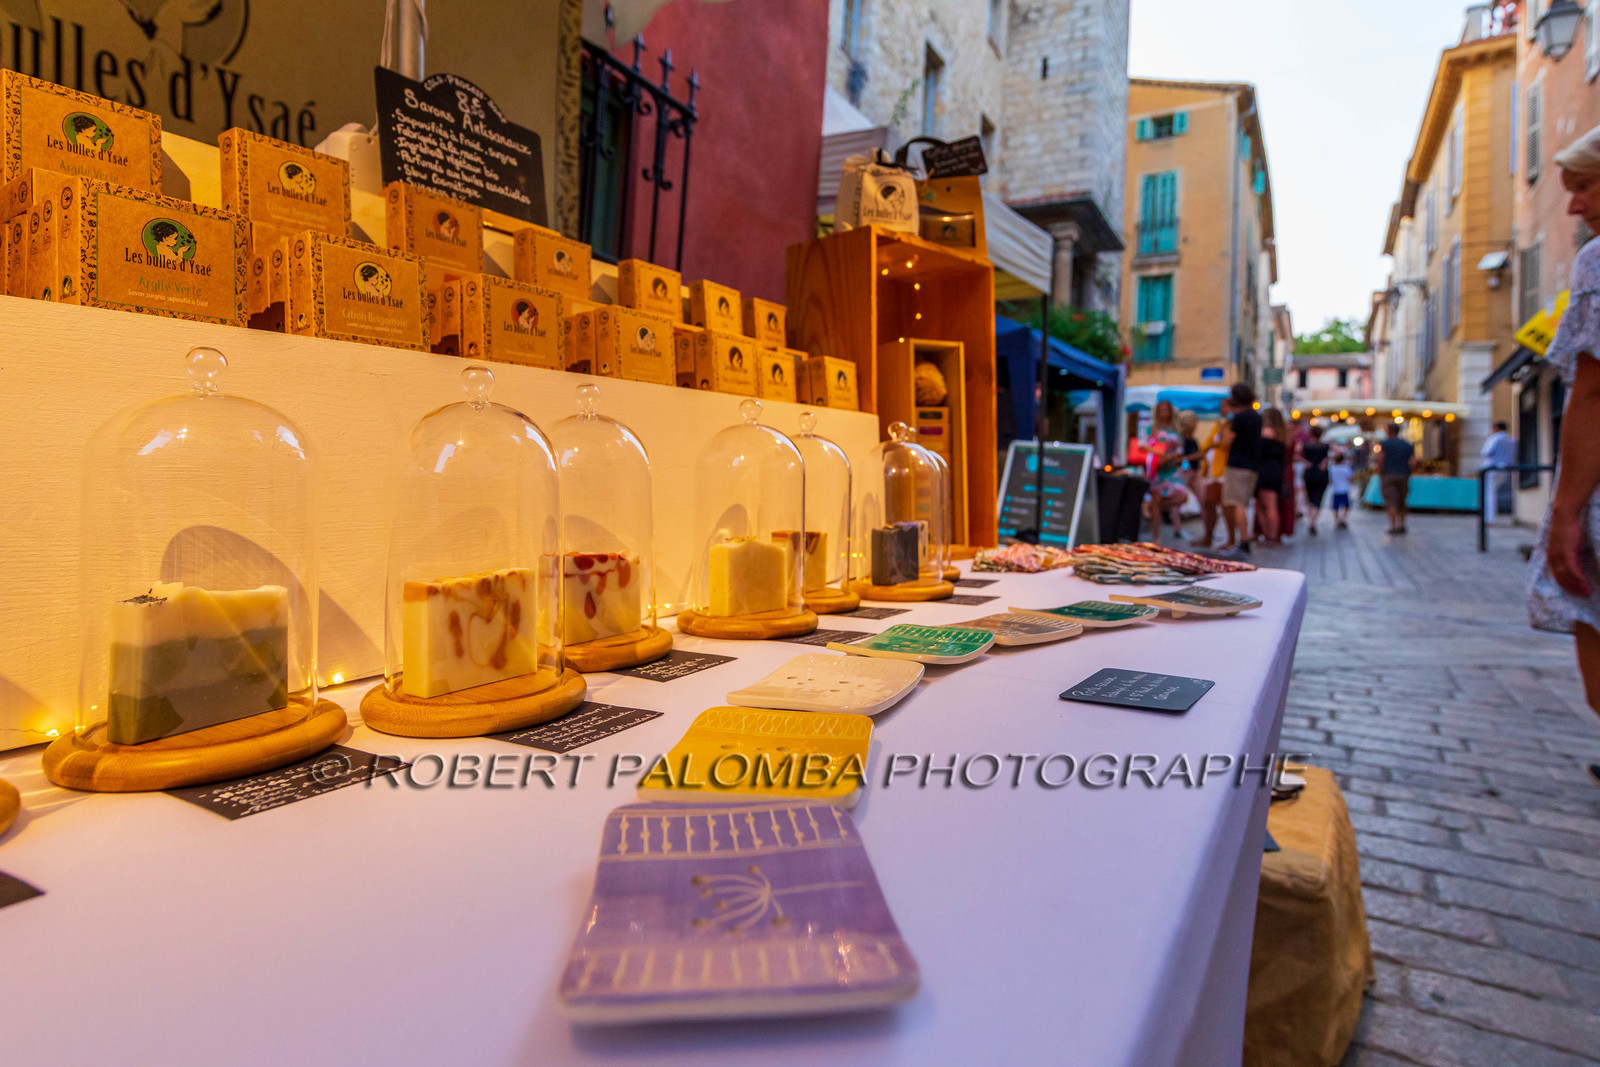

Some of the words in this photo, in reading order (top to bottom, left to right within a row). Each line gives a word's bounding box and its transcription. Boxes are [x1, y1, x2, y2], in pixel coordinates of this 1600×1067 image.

[168, 54, 316, 149] d'Ysaé
[404, 88, 455, 123] Savons
[47, 134, 64, 151] Les
[66, 140, 96, 160] bulles
[98, 149, 129, 167] d'Ysaé
[267, 181, 280, 195] Les
[125, 247, 143, 264] Les
[146, 251, 177, 272] bulles
[179, 257, 212, 277] d'Ysaé
[174, 281, 203, 297] Verte
[343, 287, 356, 300] Les
[357, 290, 379, 305] bulles
